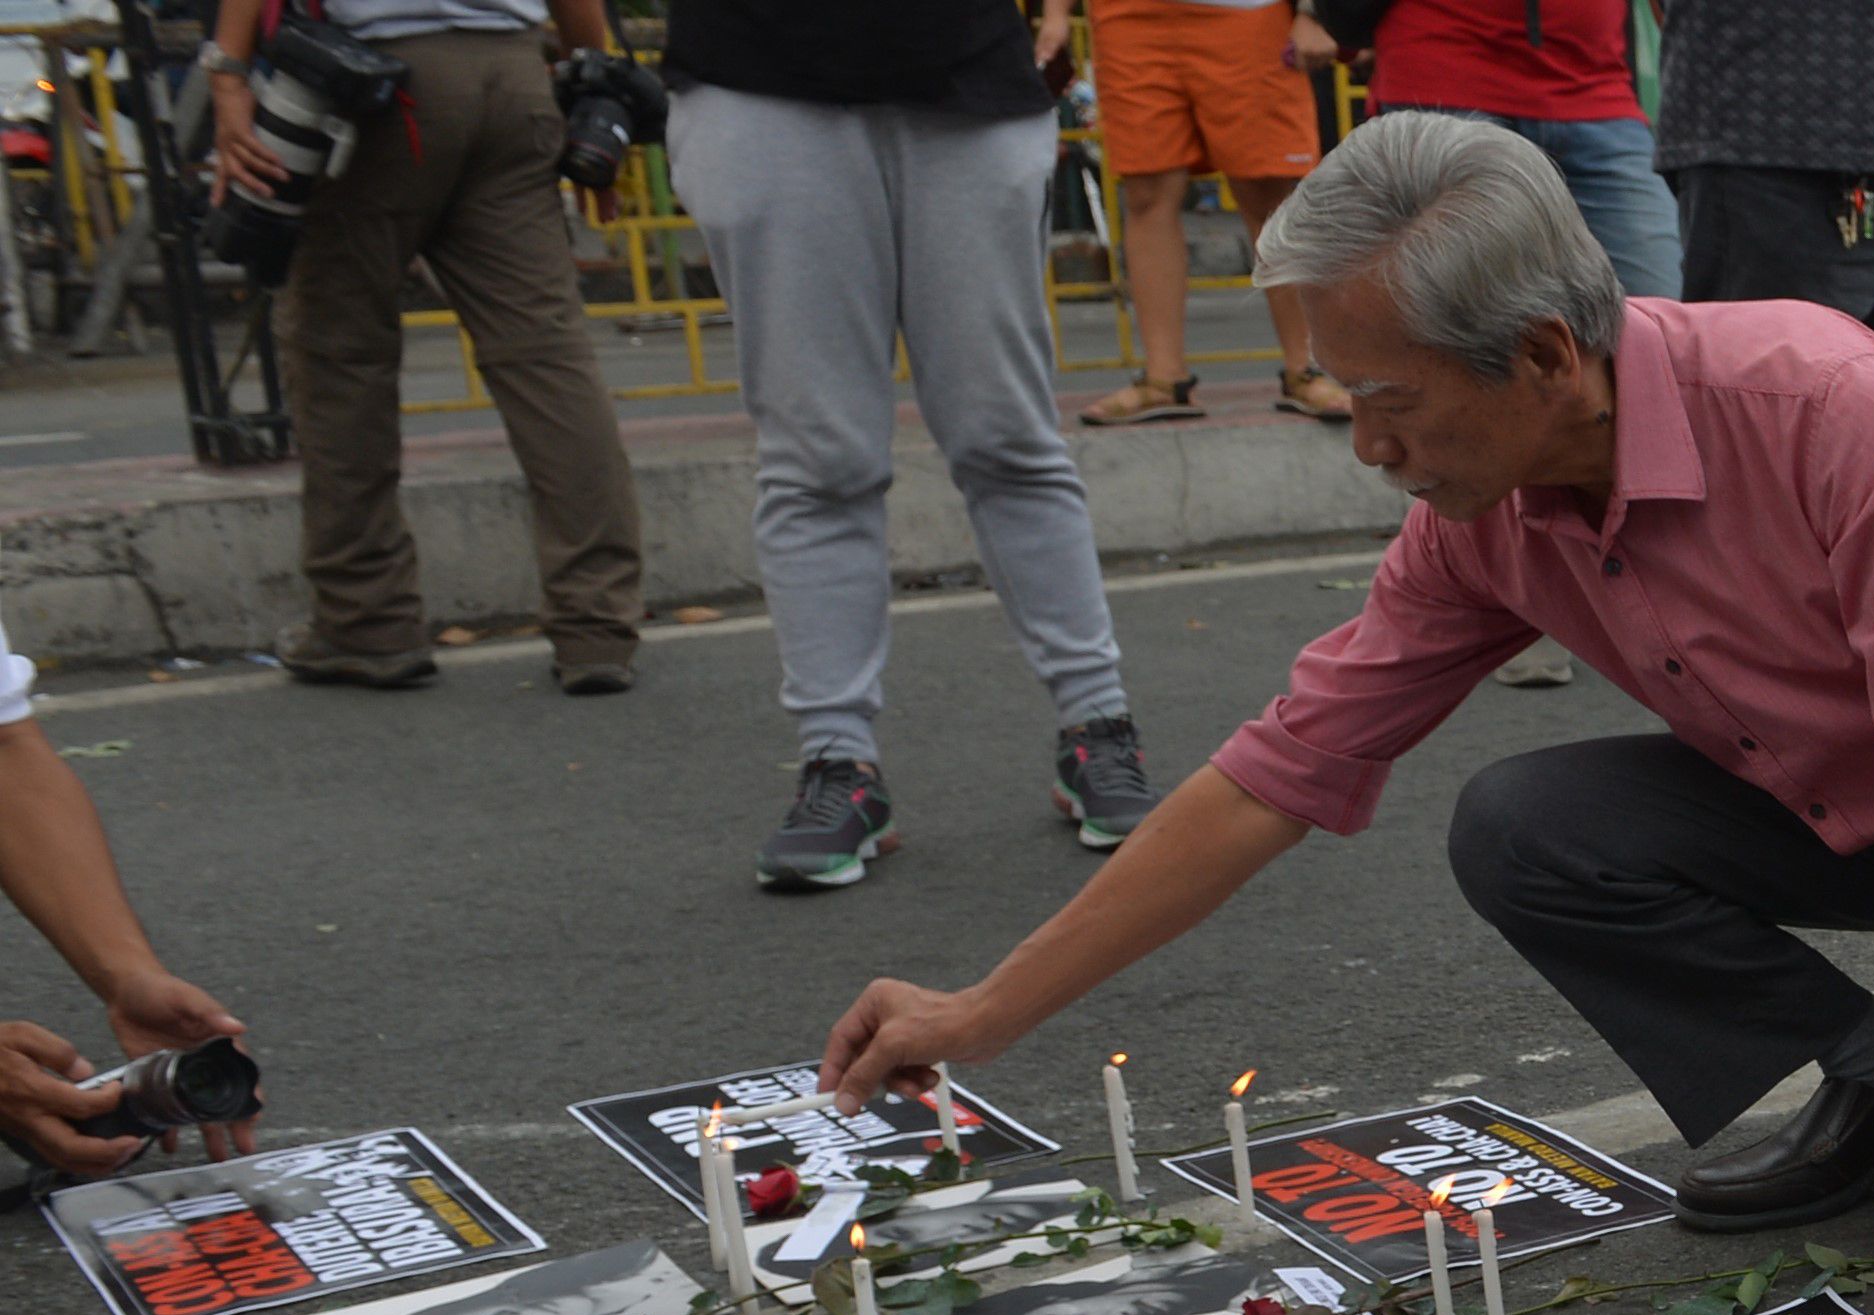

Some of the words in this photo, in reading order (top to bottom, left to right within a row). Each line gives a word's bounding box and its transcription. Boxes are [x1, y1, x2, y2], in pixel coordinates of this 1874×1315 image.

[1367, 1139, 1479, 1177] TO
[1402, 1113, 1522, 1161] CHA-CHA!
[1232, 1159, 1365, 1204] TO
[1488, 1154, 1544, 1172] &
[162, 1189, 250, 1222] NI
[1414, 1165, 1541, 1212] NO
[1513, 1166, 1624, 1217] CON-ASS
[87, 1206, 177, 1240] AT
[317, 1177, 466, 1268] IBASURA!
[1283, 1188, 1443, 1244] NO
[179, 1209, 320, 1301] CHA-CHA
